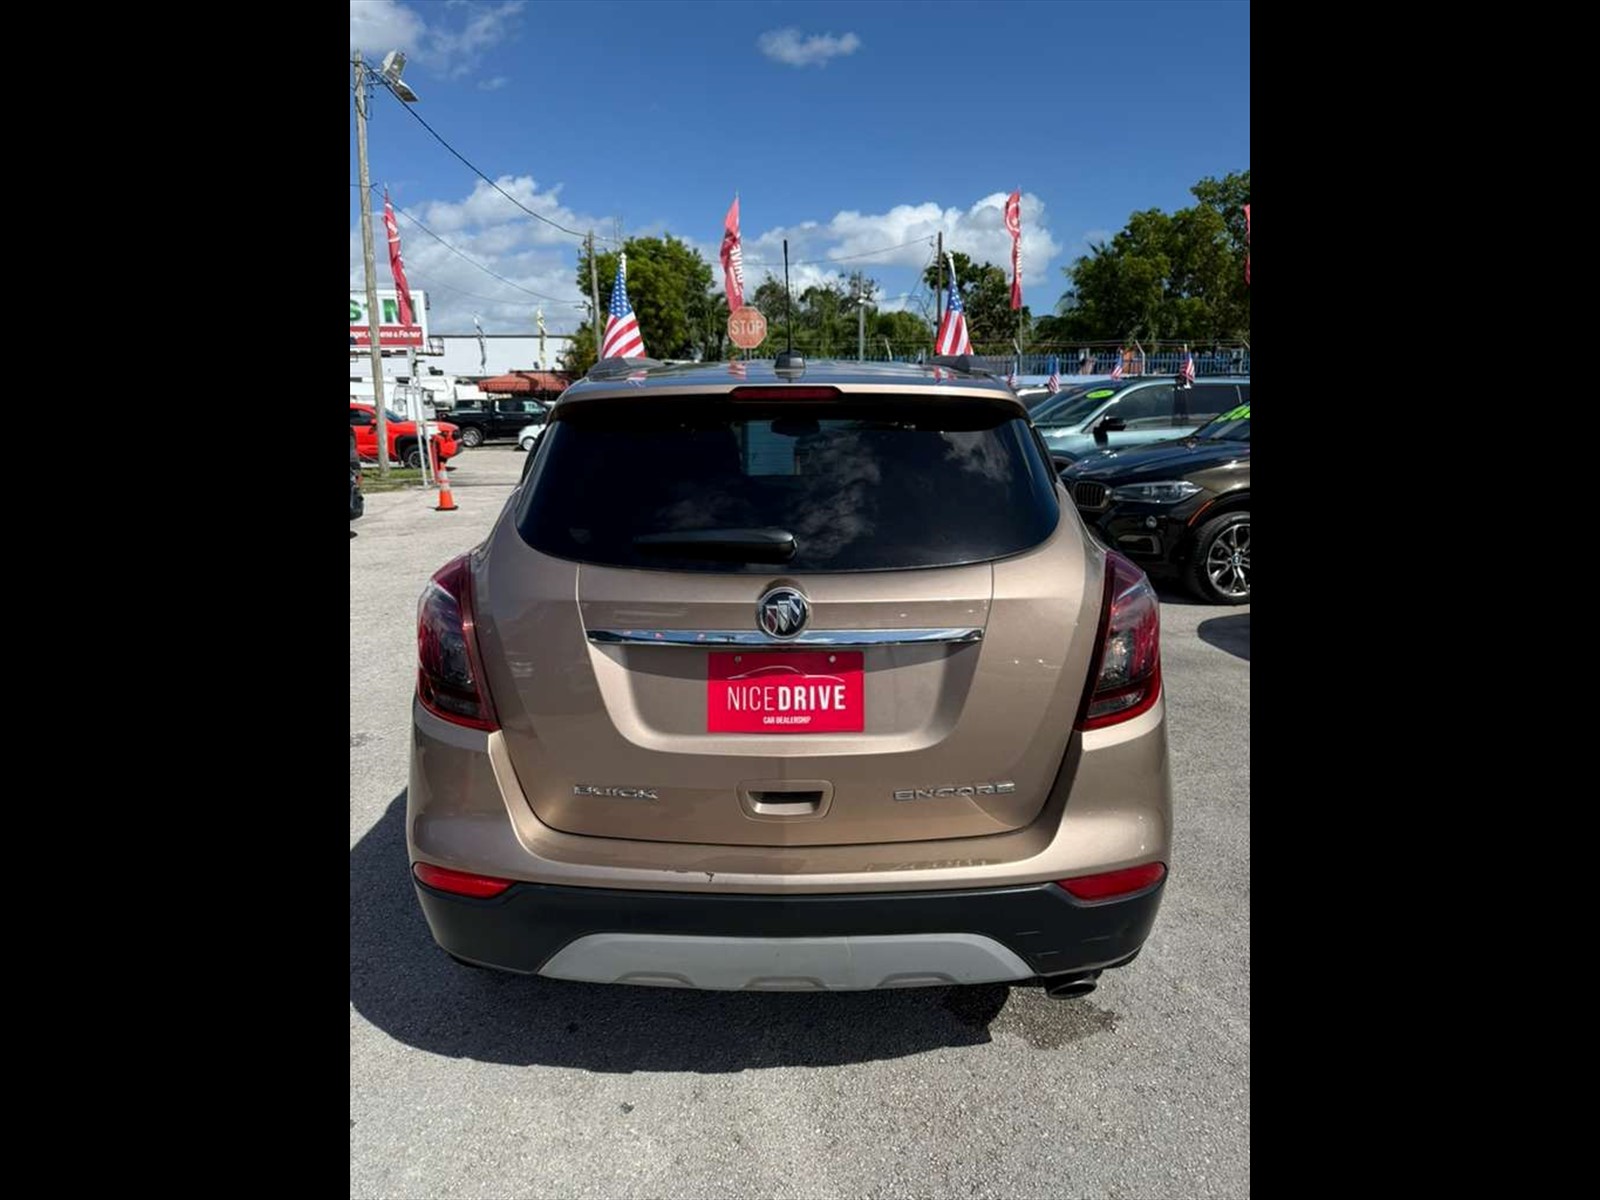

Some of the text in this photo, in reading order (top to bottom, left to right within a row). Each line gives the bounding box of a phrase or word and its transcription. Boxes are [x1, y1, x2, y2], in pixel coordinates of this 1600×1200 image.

[731, 320, 765, 335] STOP
[763, 715, 811, 725] CAR DEALERSHIP
[573, 785, 660, 800] BUICK
[893, 782, 1017, 801] ENCORE
